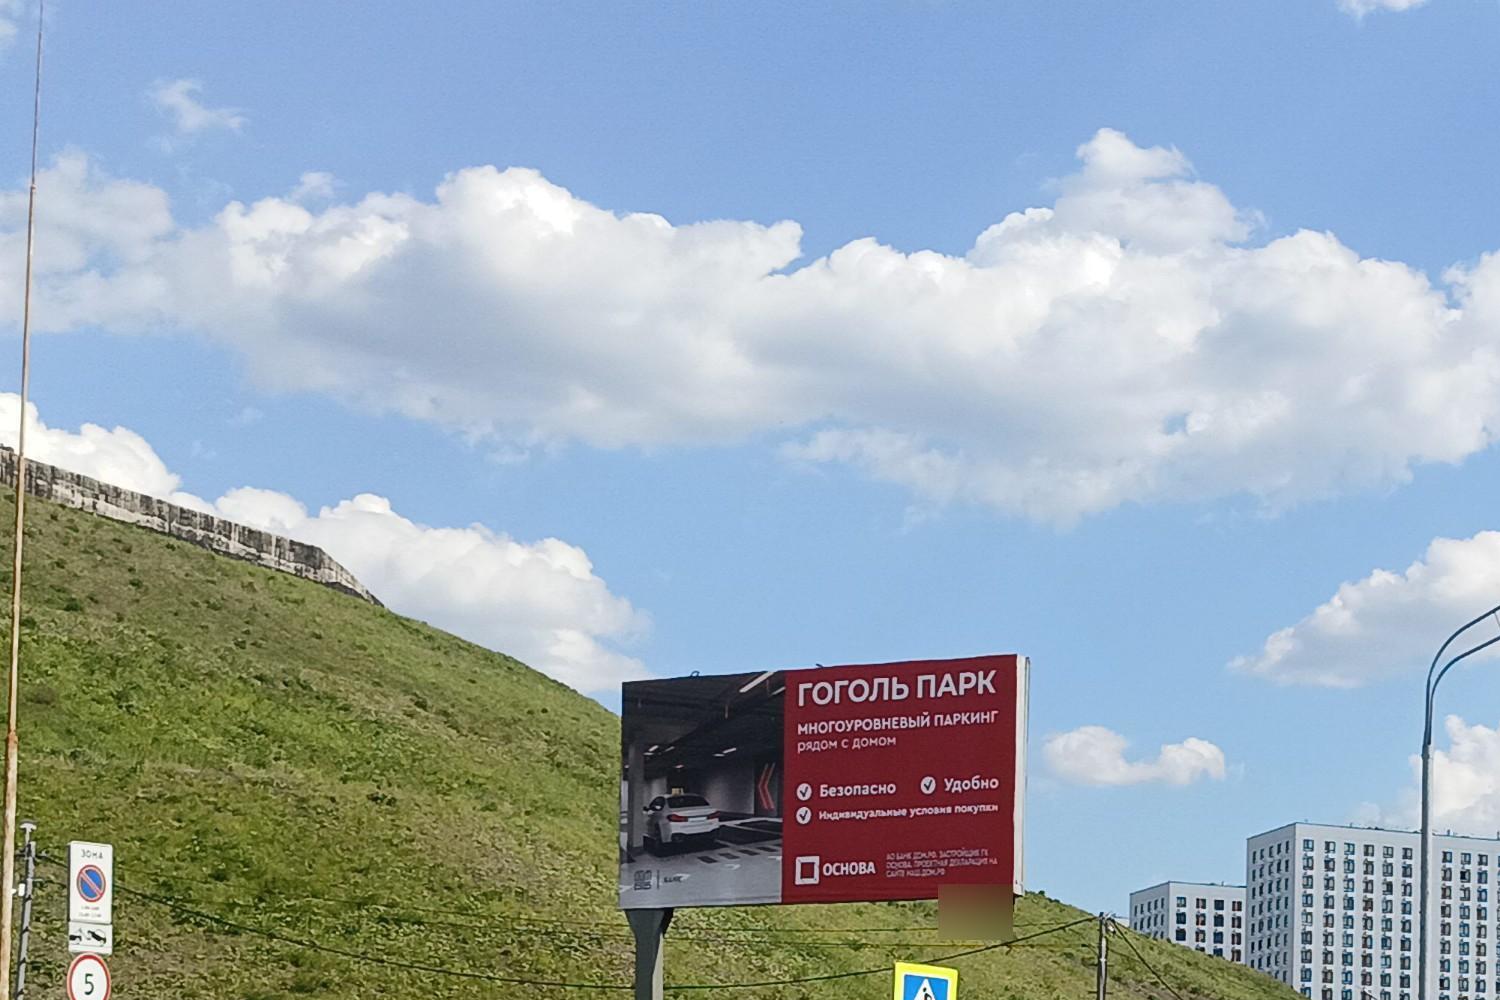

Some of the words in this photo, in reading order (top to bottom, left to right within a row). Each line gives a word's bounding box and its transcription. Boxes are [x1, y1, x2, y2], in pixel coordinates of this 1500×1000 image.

[798, 677, 910, 707] ГОГОЛЬ
[916, 670, 997, 698] ПАРК
[797, 711, 931, 735] МНОГОУРОВНЕВЫЙ
[934, 710, 999, 728] ПАРКИНГ
[819, 782, 897, 798] Безопасно
[944, 775, 1000, 793] Удобно
[818, 807, 908, 821] Индивидуальные
[909, 805, 952, 818] условия
[954, 803, 999, 815] покупки
[81, 849, 103, 859] ЗОНА
[822, 861, 876, 876] ОСНОВА
[84, 973, 94, 996] 5
